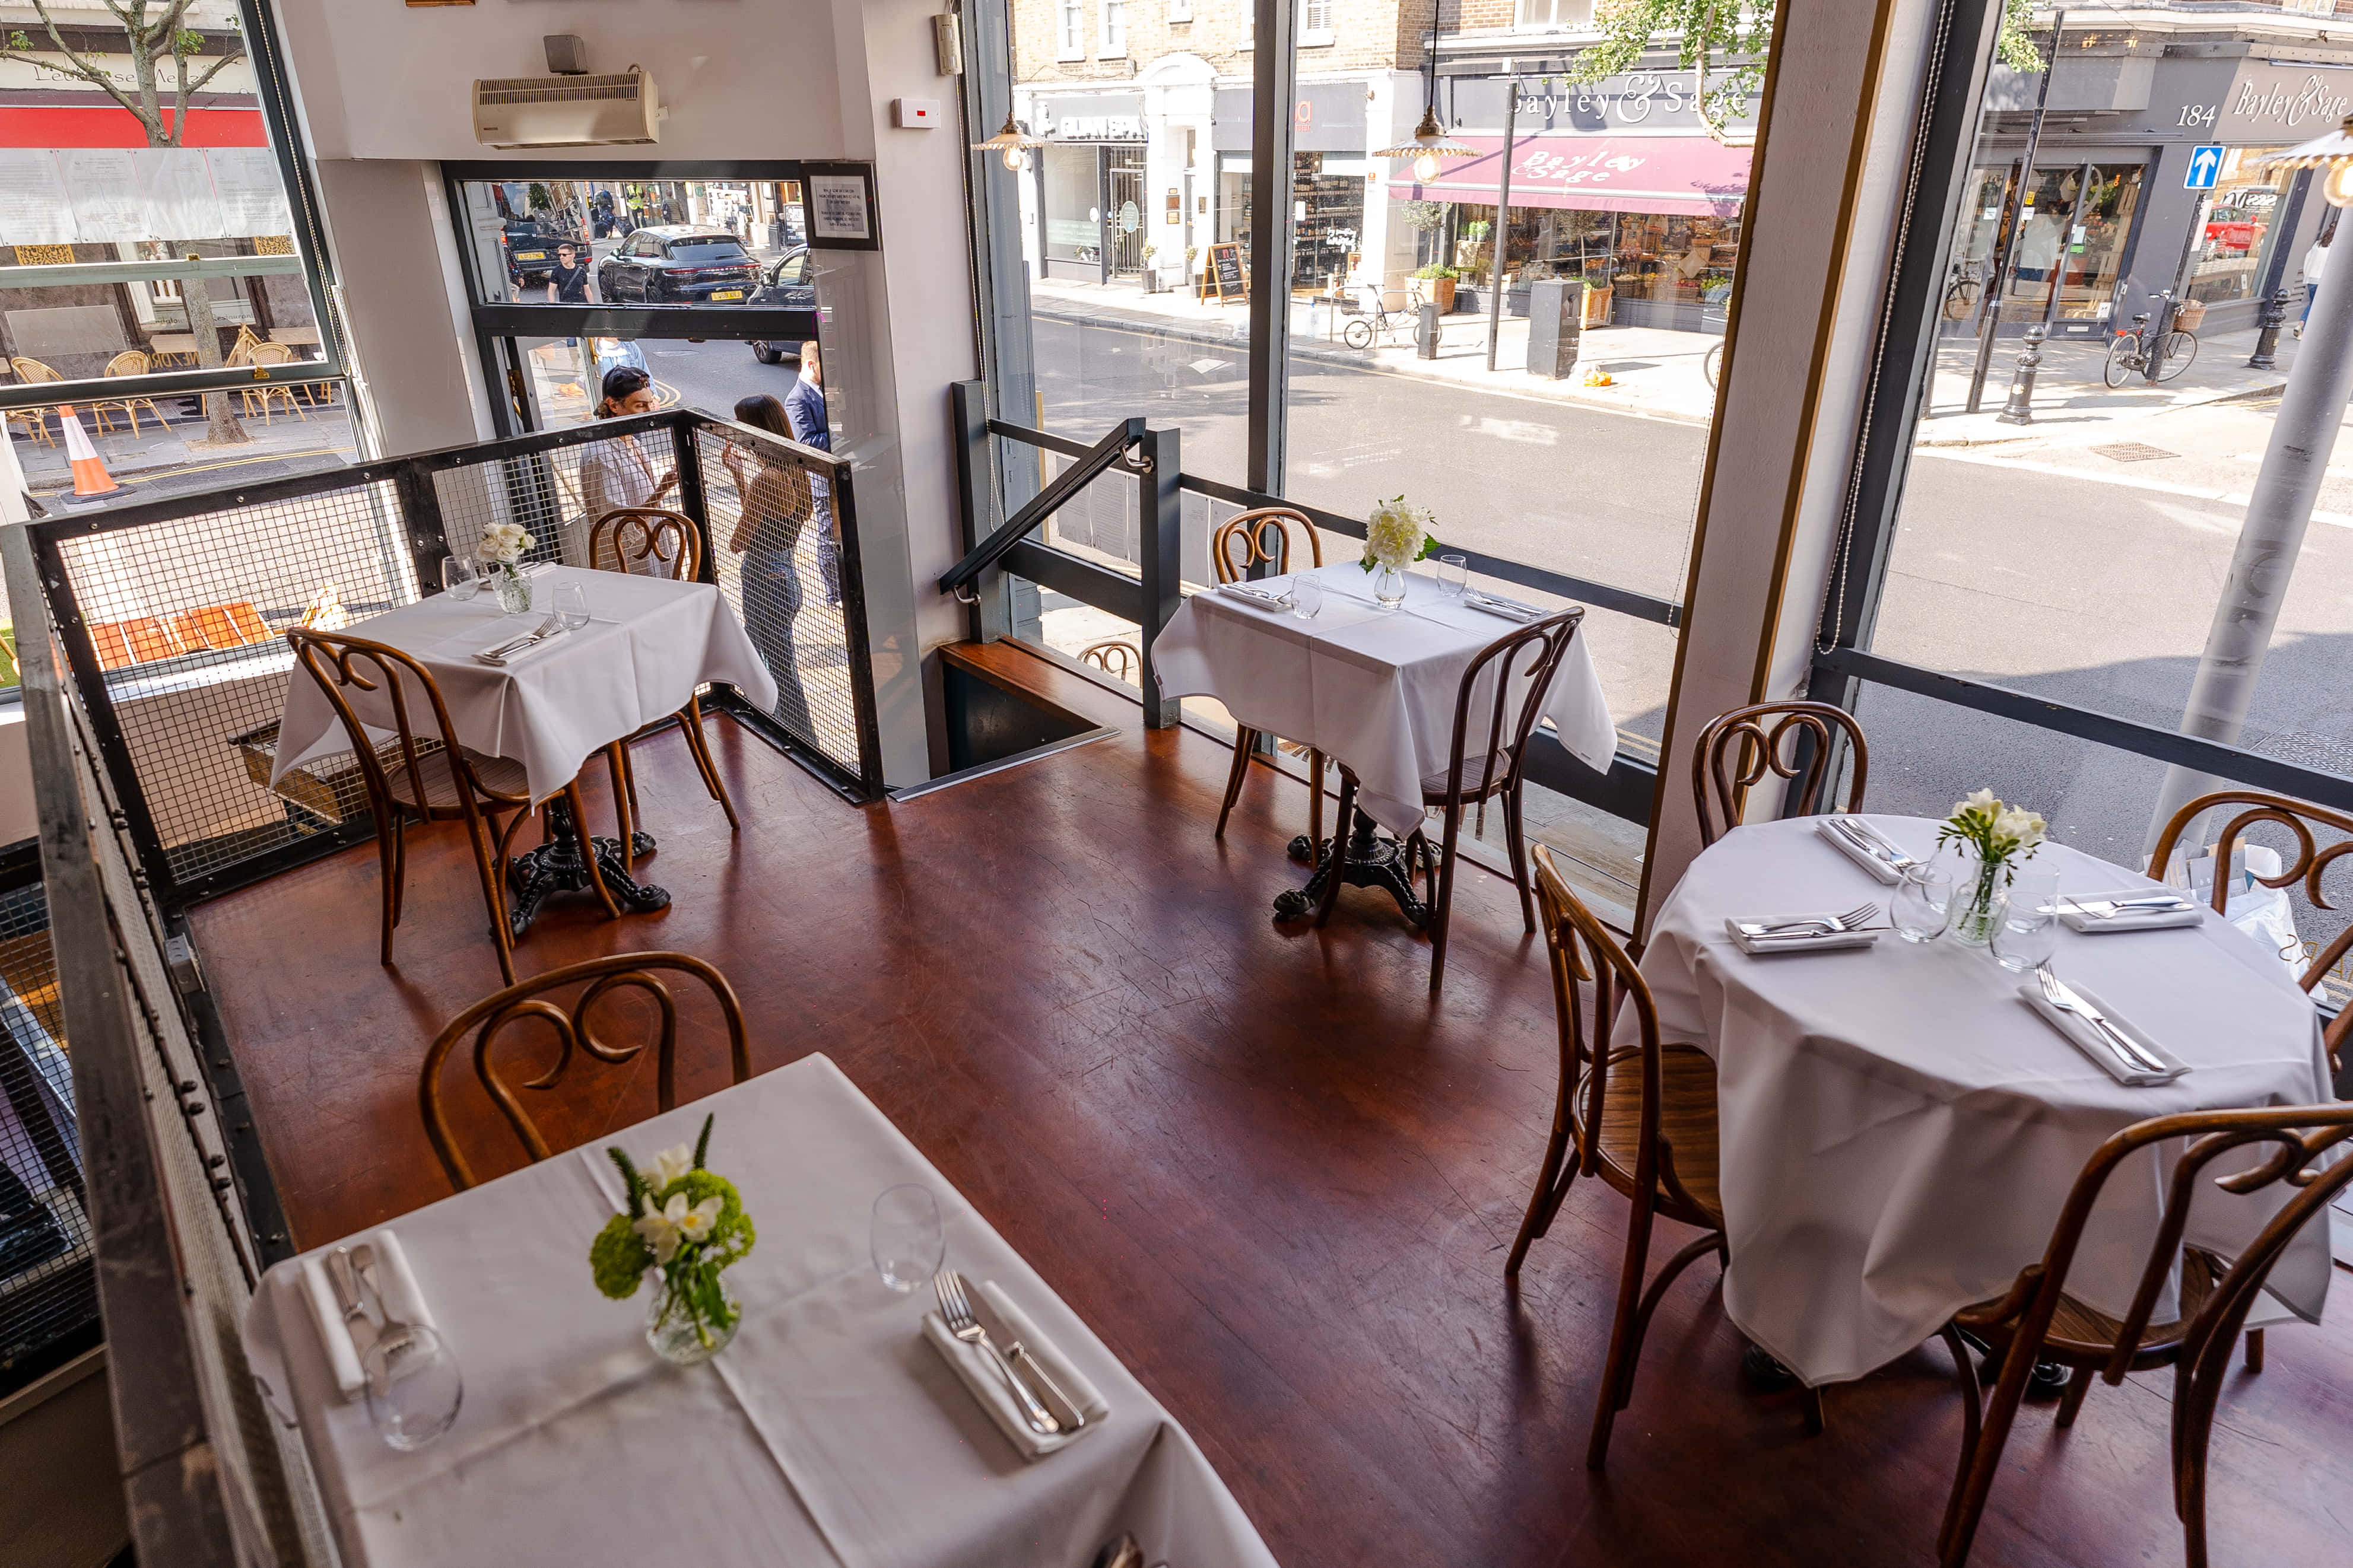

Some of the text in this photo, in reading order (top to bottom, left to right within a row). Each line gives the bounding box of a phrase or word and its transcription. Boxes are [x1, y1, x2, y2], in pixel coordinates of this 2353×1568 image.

[1616, 74, 1661, 123] &
[2234, 75, 2348, 126] Bayley & Sage
[2176, 104, 2217, 128] 184
[1520, 151, 1647, 171] Bayley
[1526, 165, 1611, 183] Sage
